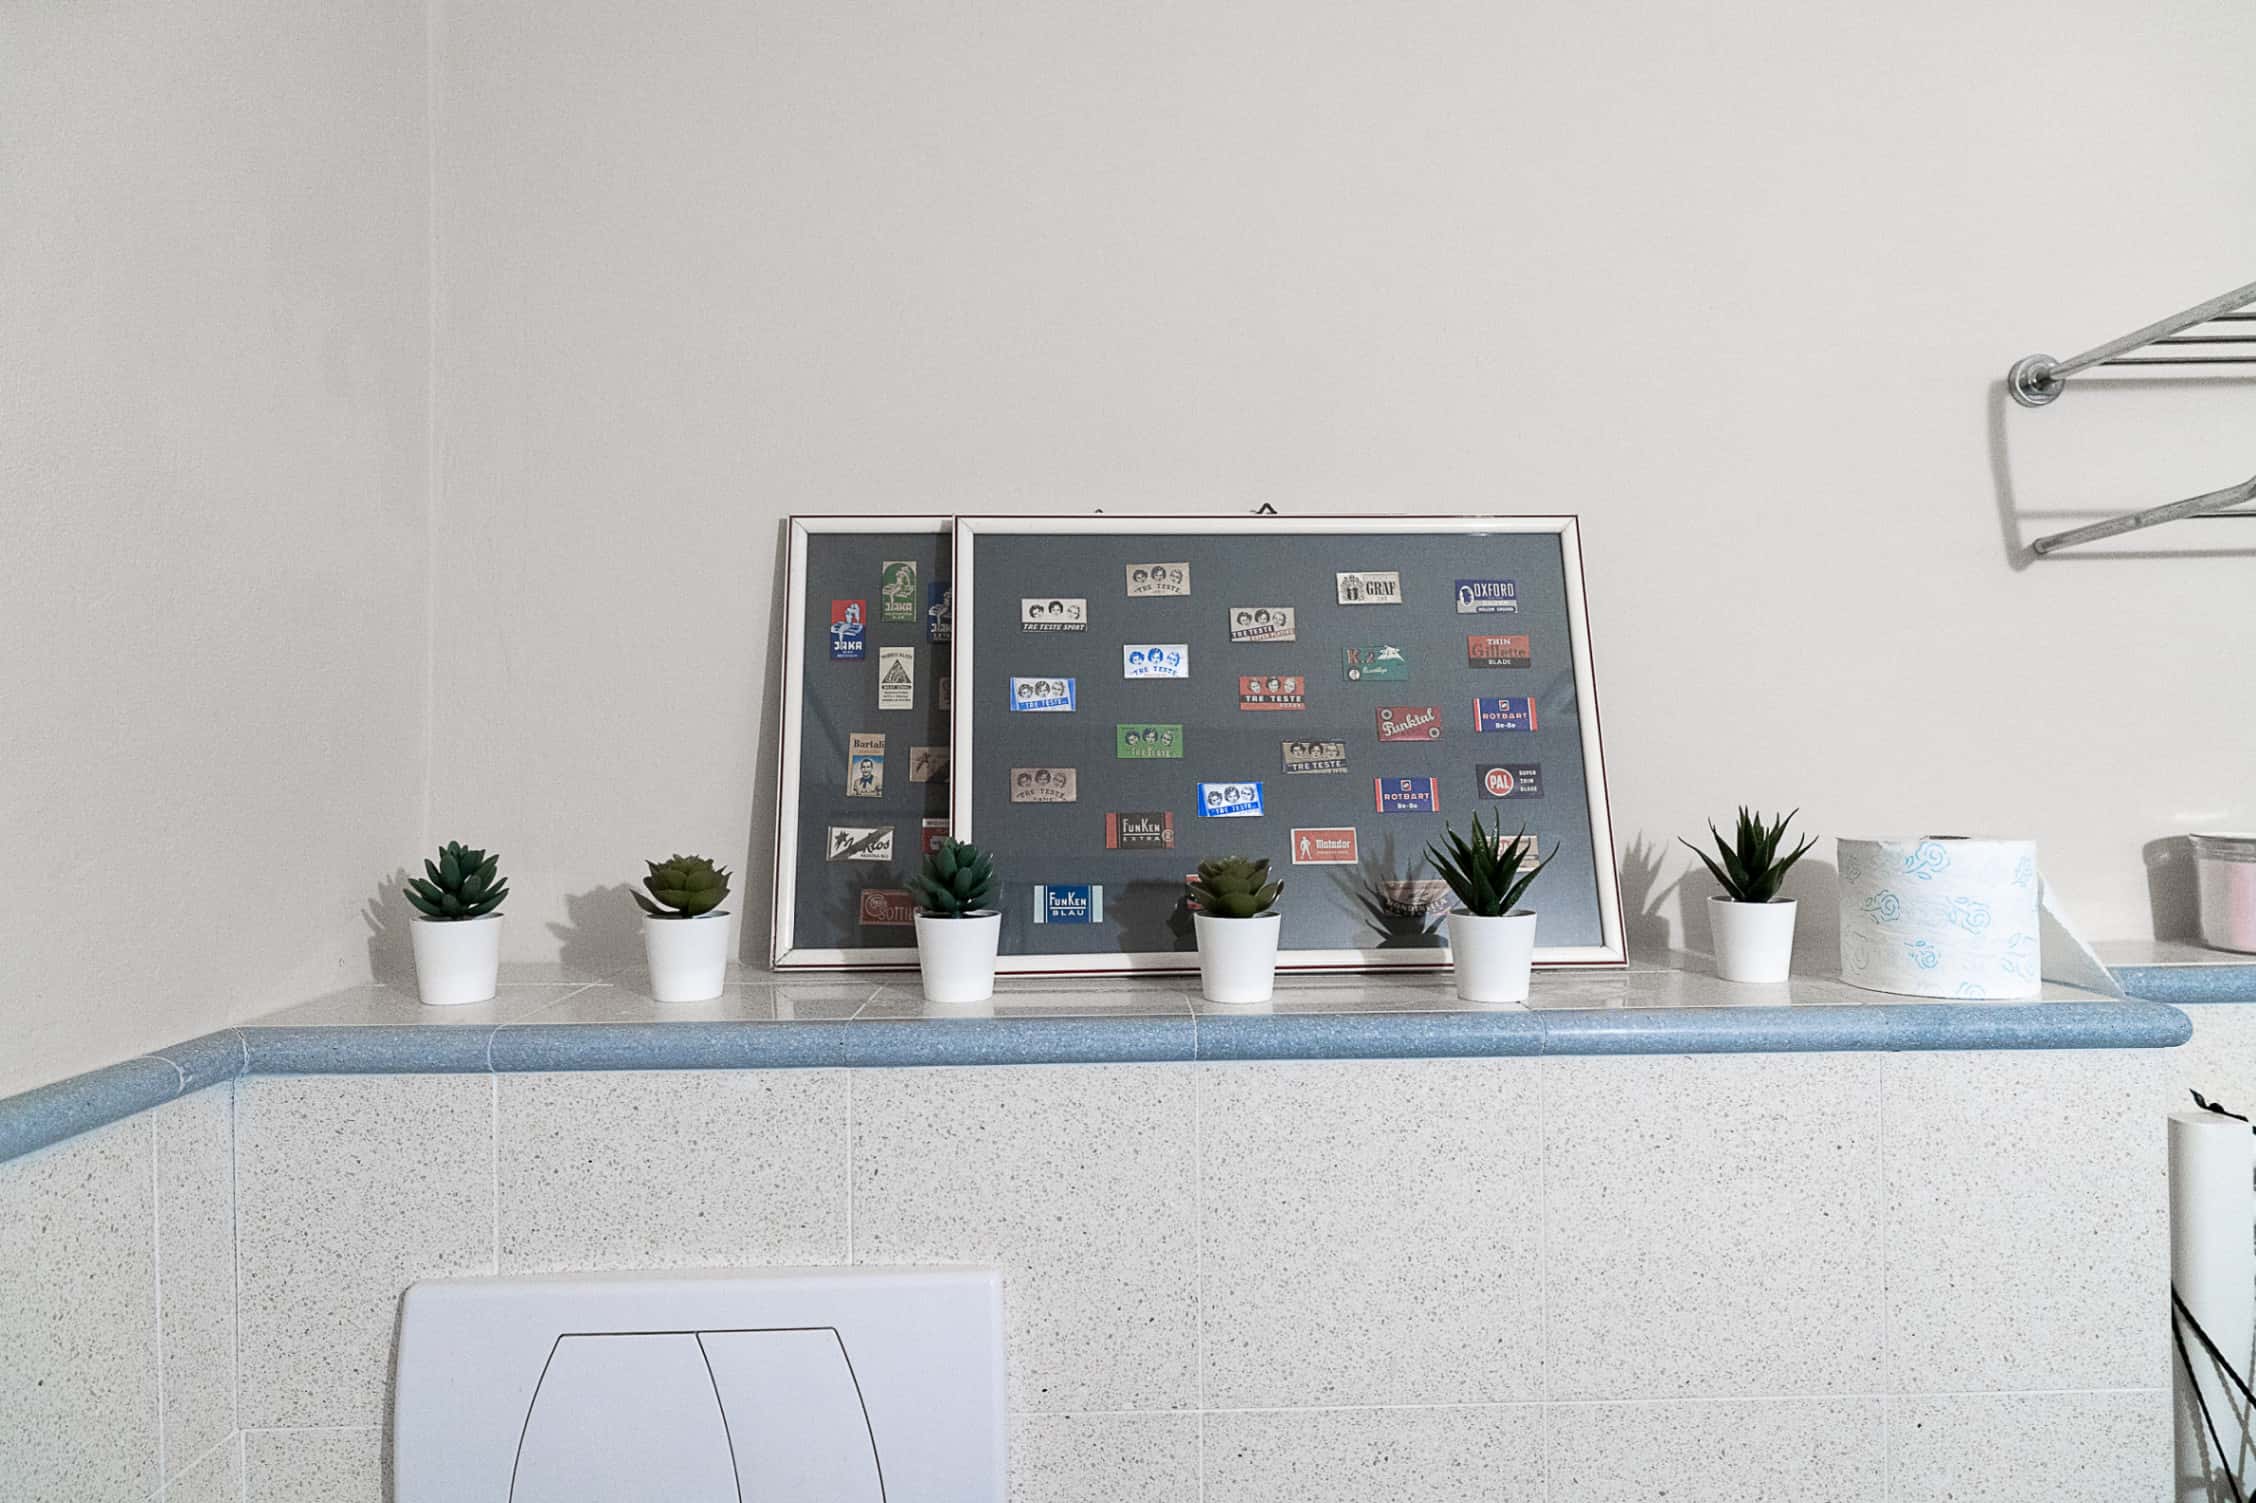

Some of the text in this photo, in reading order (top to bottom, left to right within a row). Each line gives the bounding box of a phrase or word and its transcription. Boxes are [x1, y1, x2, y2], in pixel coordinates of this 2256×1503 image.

[1366, 580, 1396, 595] GRAF
[1474, 583, 1514, 597] OXFORD
[834, 641, 863, 650] JAKA
[1471, 643, 1526, 658] Gillette
[1382, 708, 1435, 737] Punktal
[854, 739, 885, 749] Bartali
[1293, 760, 1341, 771] TRE TESTE
[1490, 775, 1509, 789] PAL
[1316, 839, 1351, 849] Matador
